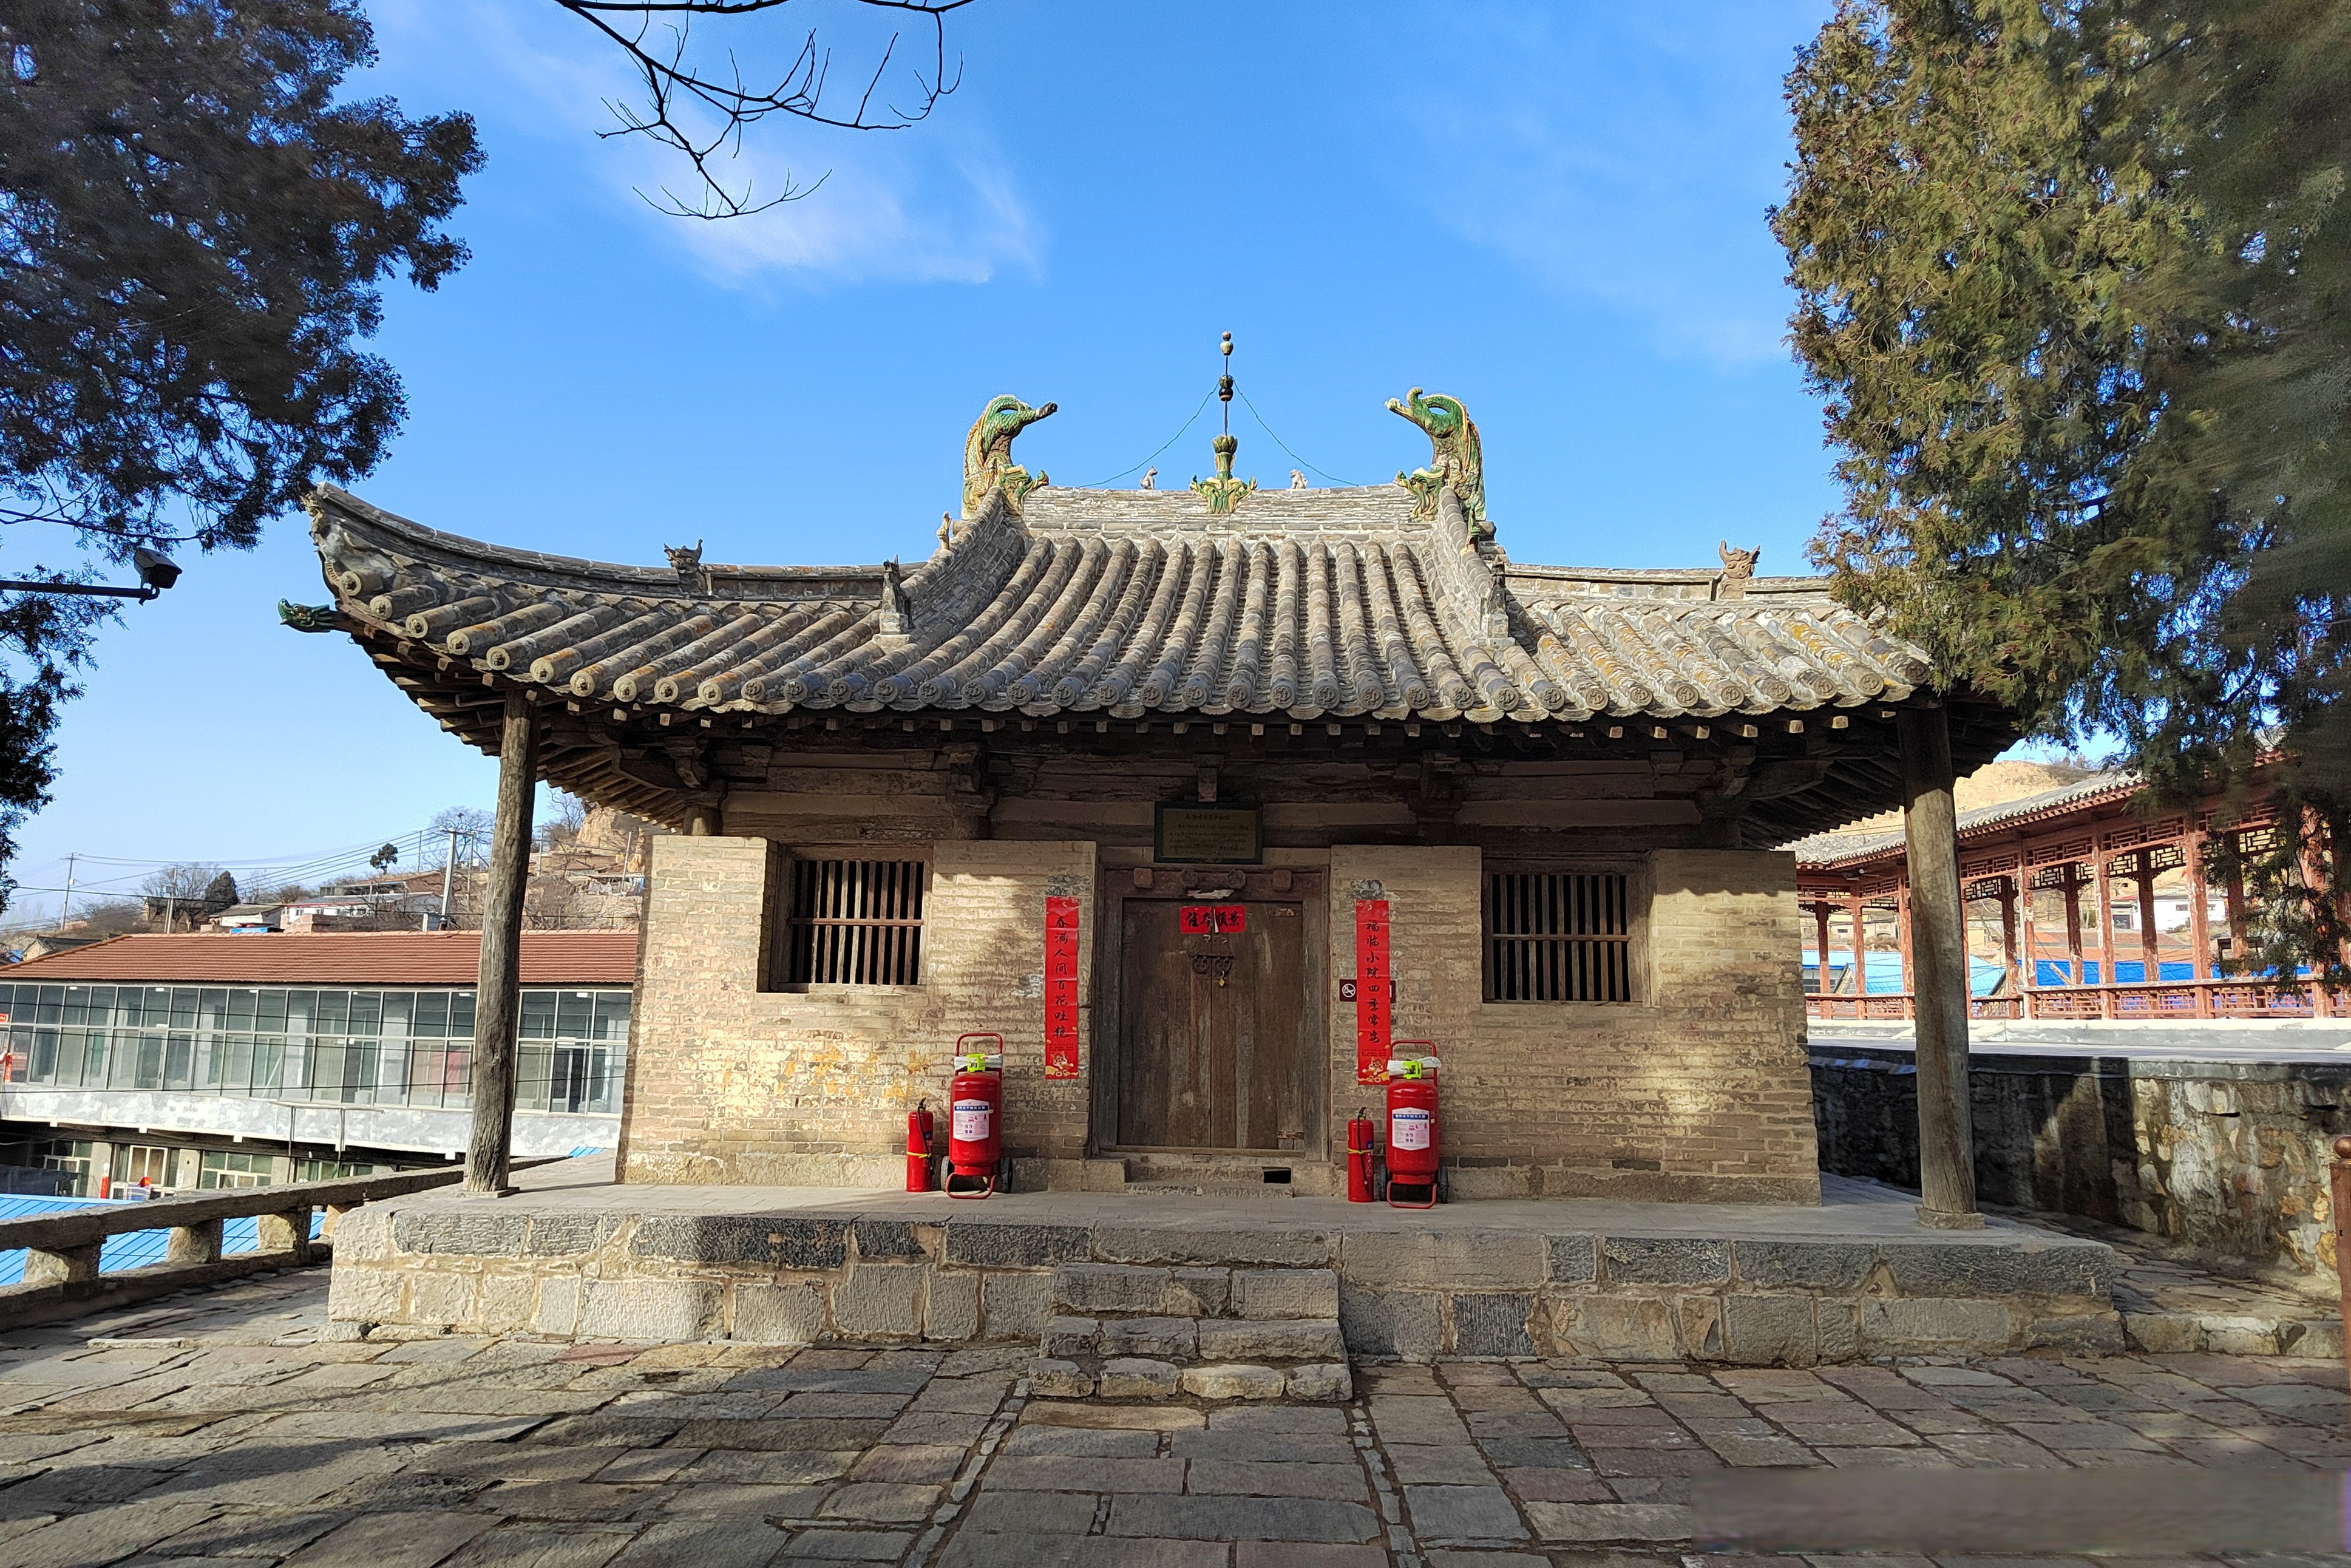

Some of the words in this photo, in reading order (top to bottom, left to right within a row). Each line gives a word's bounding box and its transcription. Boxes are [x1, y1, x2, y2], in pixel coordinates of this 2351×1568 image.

[1053, 915, 1070, 1038] 春满人间百花吐艳
[1366, 920, 1382, 1044] 福临小院四季常安
